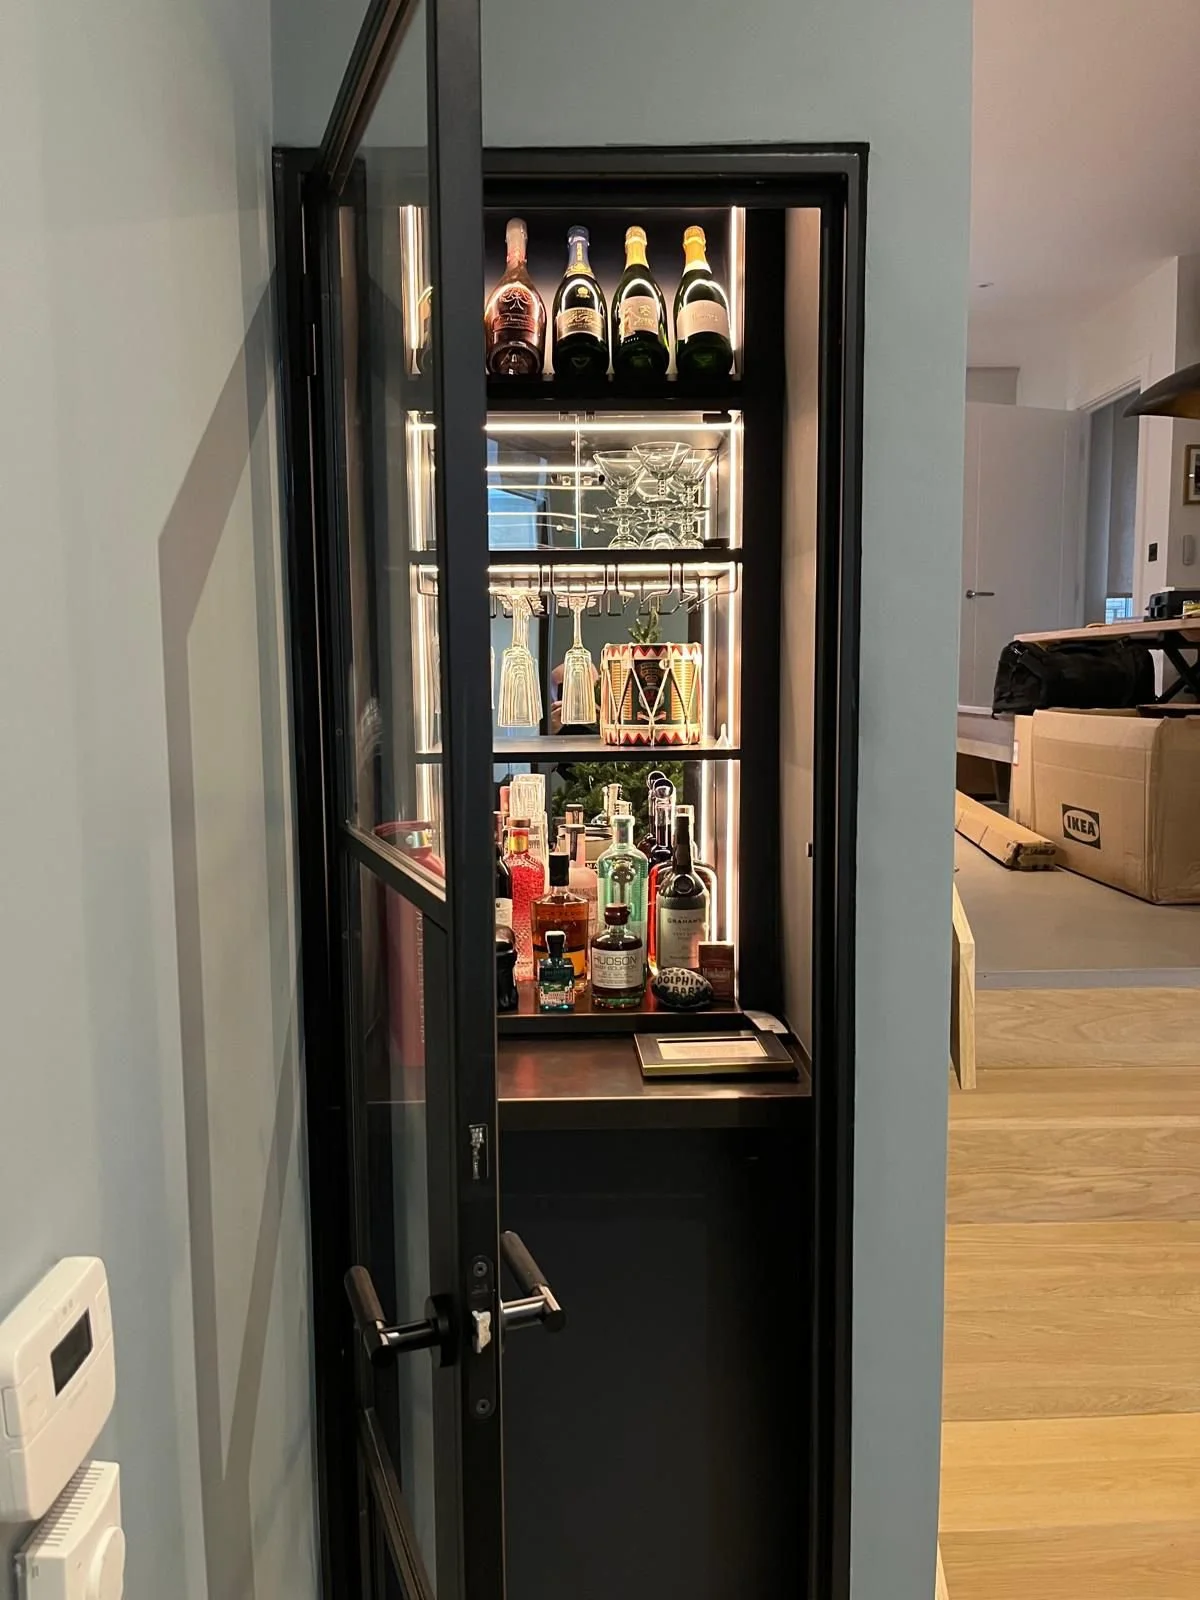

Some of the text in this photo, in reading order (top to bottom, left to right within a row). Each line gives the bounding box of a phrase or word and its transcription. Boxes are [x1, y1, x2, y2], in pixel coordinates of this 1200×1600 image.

[1067, 815, 1097, 837] IKEA
[593, 954, 637, 966] HUDSON
[657, 976, 704, 986] DOLPHIN
